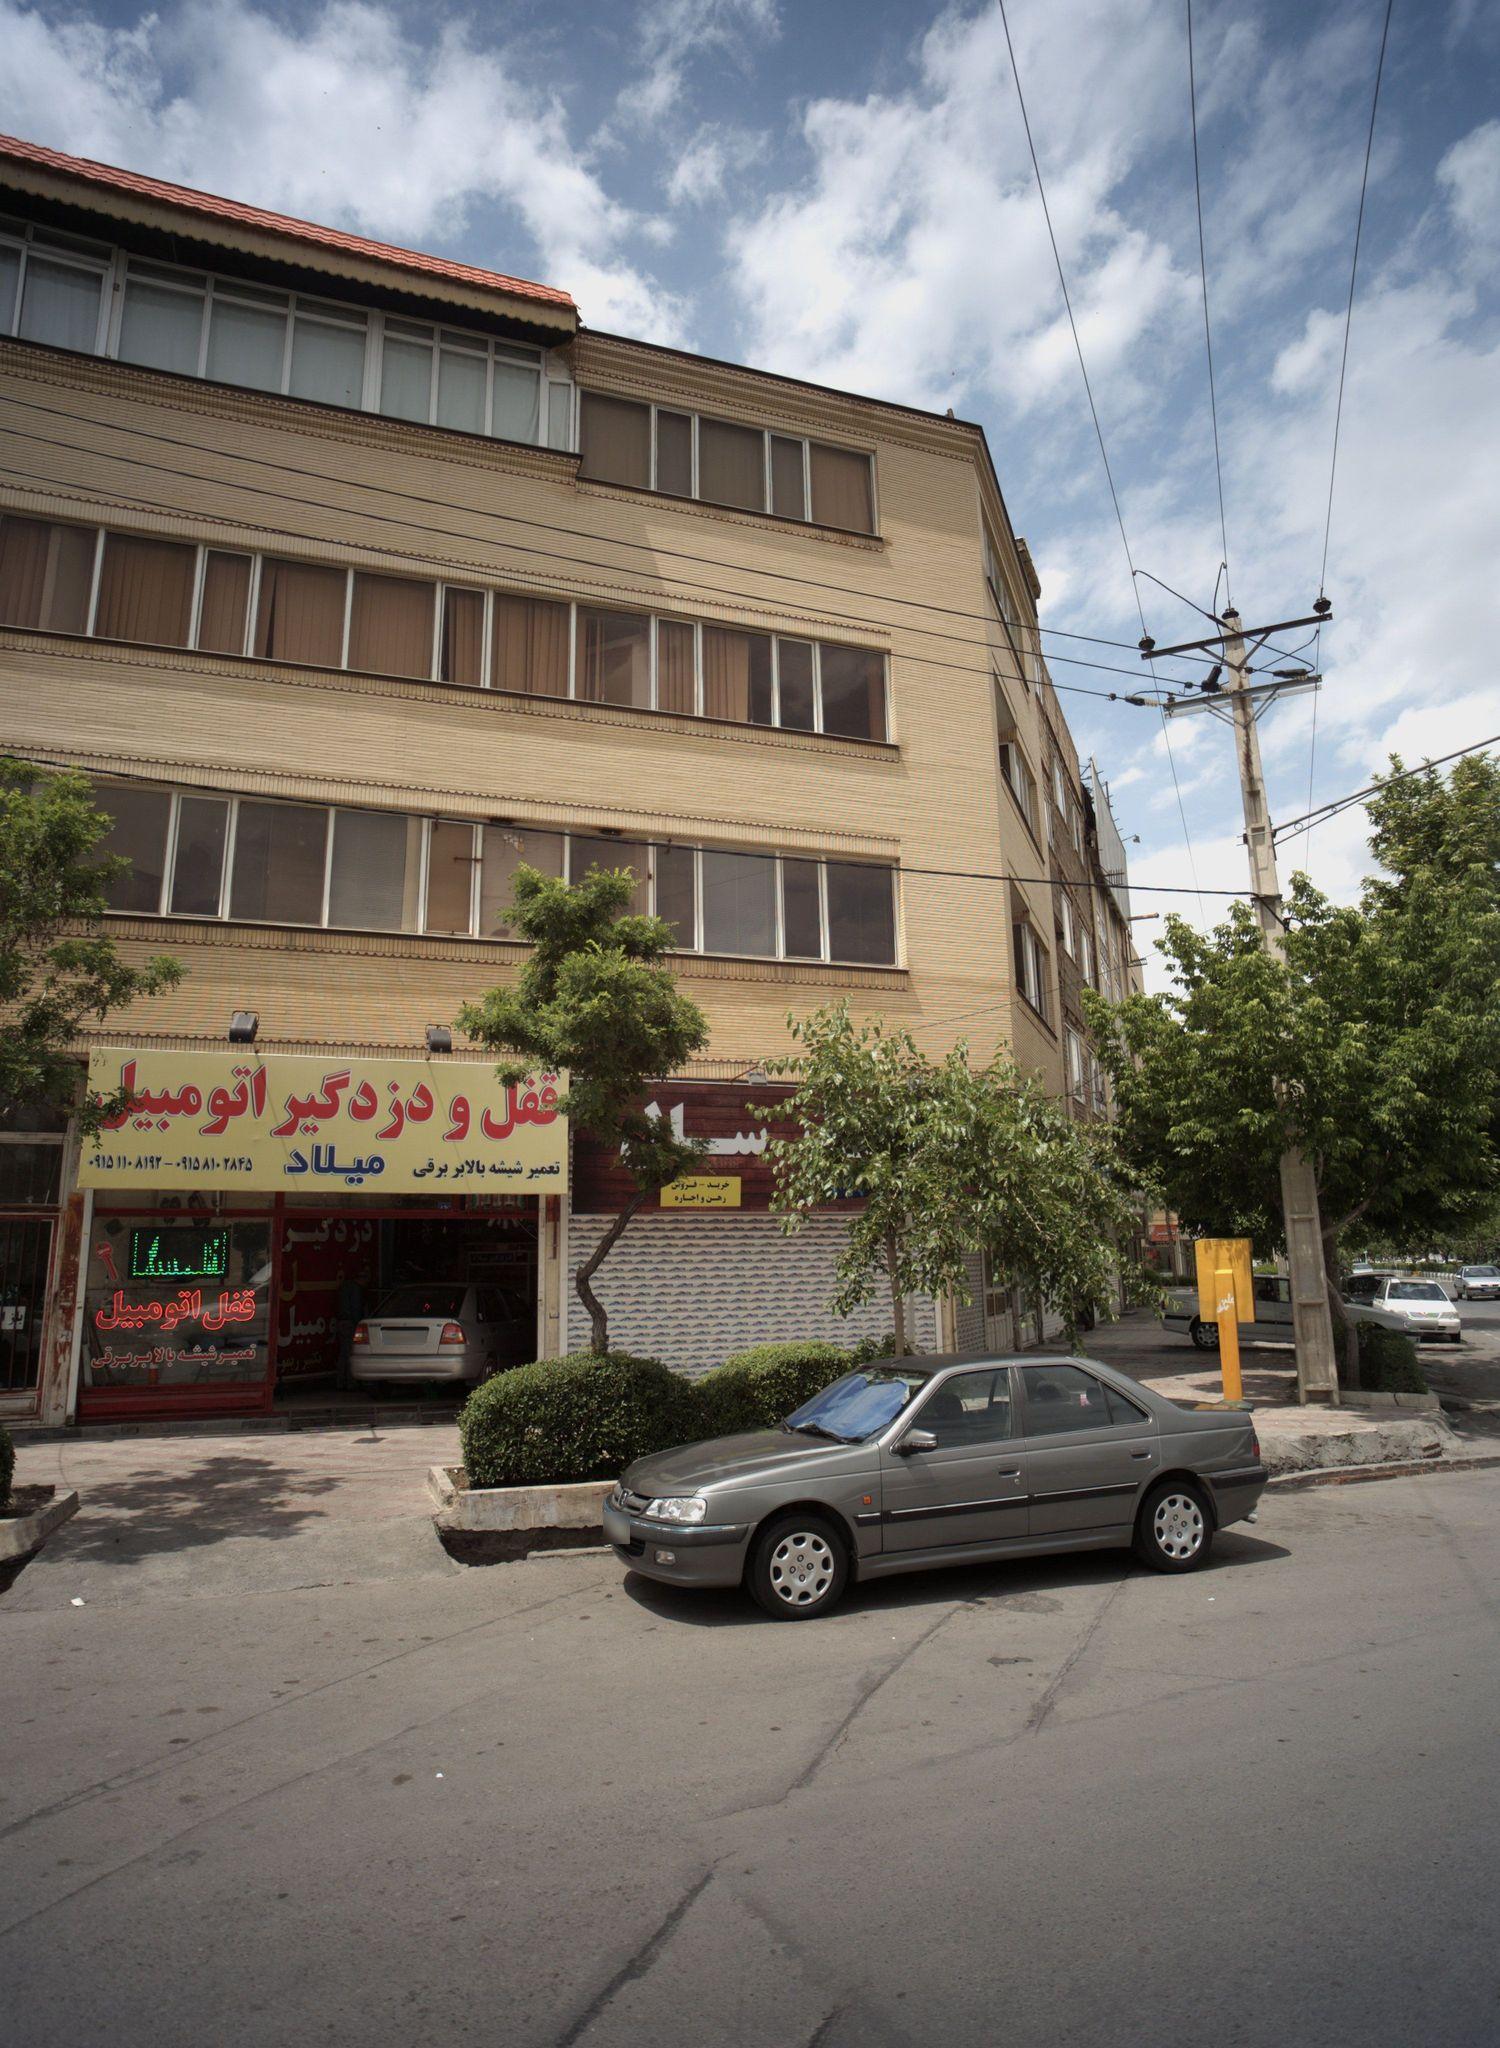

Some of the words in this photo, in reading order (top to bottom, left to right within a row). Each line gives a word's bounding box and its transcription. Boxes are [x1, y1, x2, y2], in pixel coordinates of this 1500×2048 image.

[97, 1059, 267, 1135] اتومبیل
[271, 1068, 434, 1140] دزدگیر
[443, 1095, 471, 1141] و
[482, 1072, 558, 1140] قفل
[284, 1143, 386, 1185] میلاد
[413, 1158, 448, 1179] برقی
[489, 1160, 523, 1179] شیشه
[526, 1160, 560, 1180] تعمیر
[95, 1289, 202, 1330] اتومبیل
[202, 1289, 256, 1331] قفل
[277, 1304, 337, 1347] ومبیل
[177, 1345, 216, 1366] شیشه
[215, 1344, 257, 1365] تعمیر
